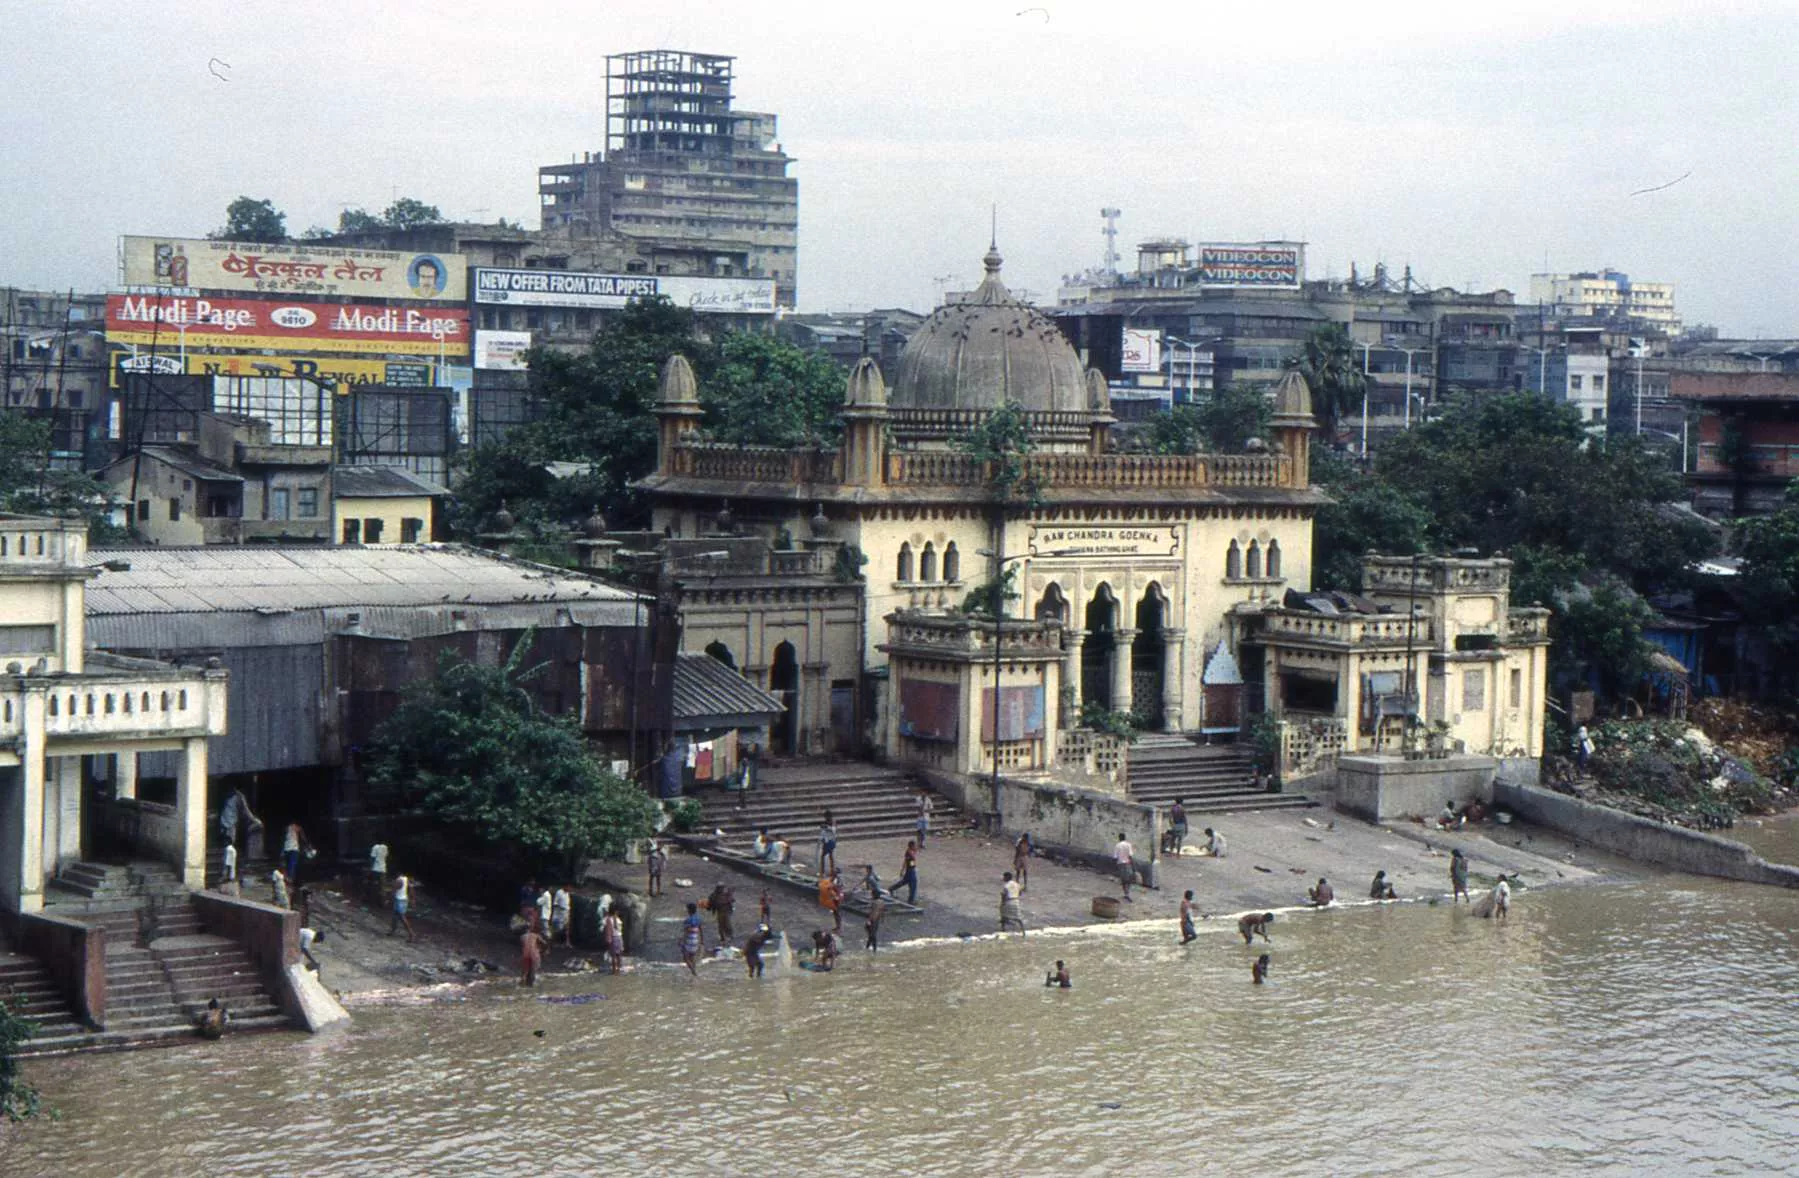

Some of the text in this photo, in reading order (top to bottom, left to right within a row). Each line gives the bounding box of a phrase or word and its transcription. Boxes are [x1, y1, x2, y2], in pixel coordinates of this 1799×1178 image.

[1204, 250, 1294, 263] VIDEOCON
[1204, 268, 1294, 280] VIDEOCON
[480, 272, 655, 296] NEW OFFER FROM TATA PIPES!
[122, 297, 251, 331] Modi Page
[338, 307, 458, 340] Modi Page
[1043, 530, 1158, 544] RAM CHANDRA GOENKA
